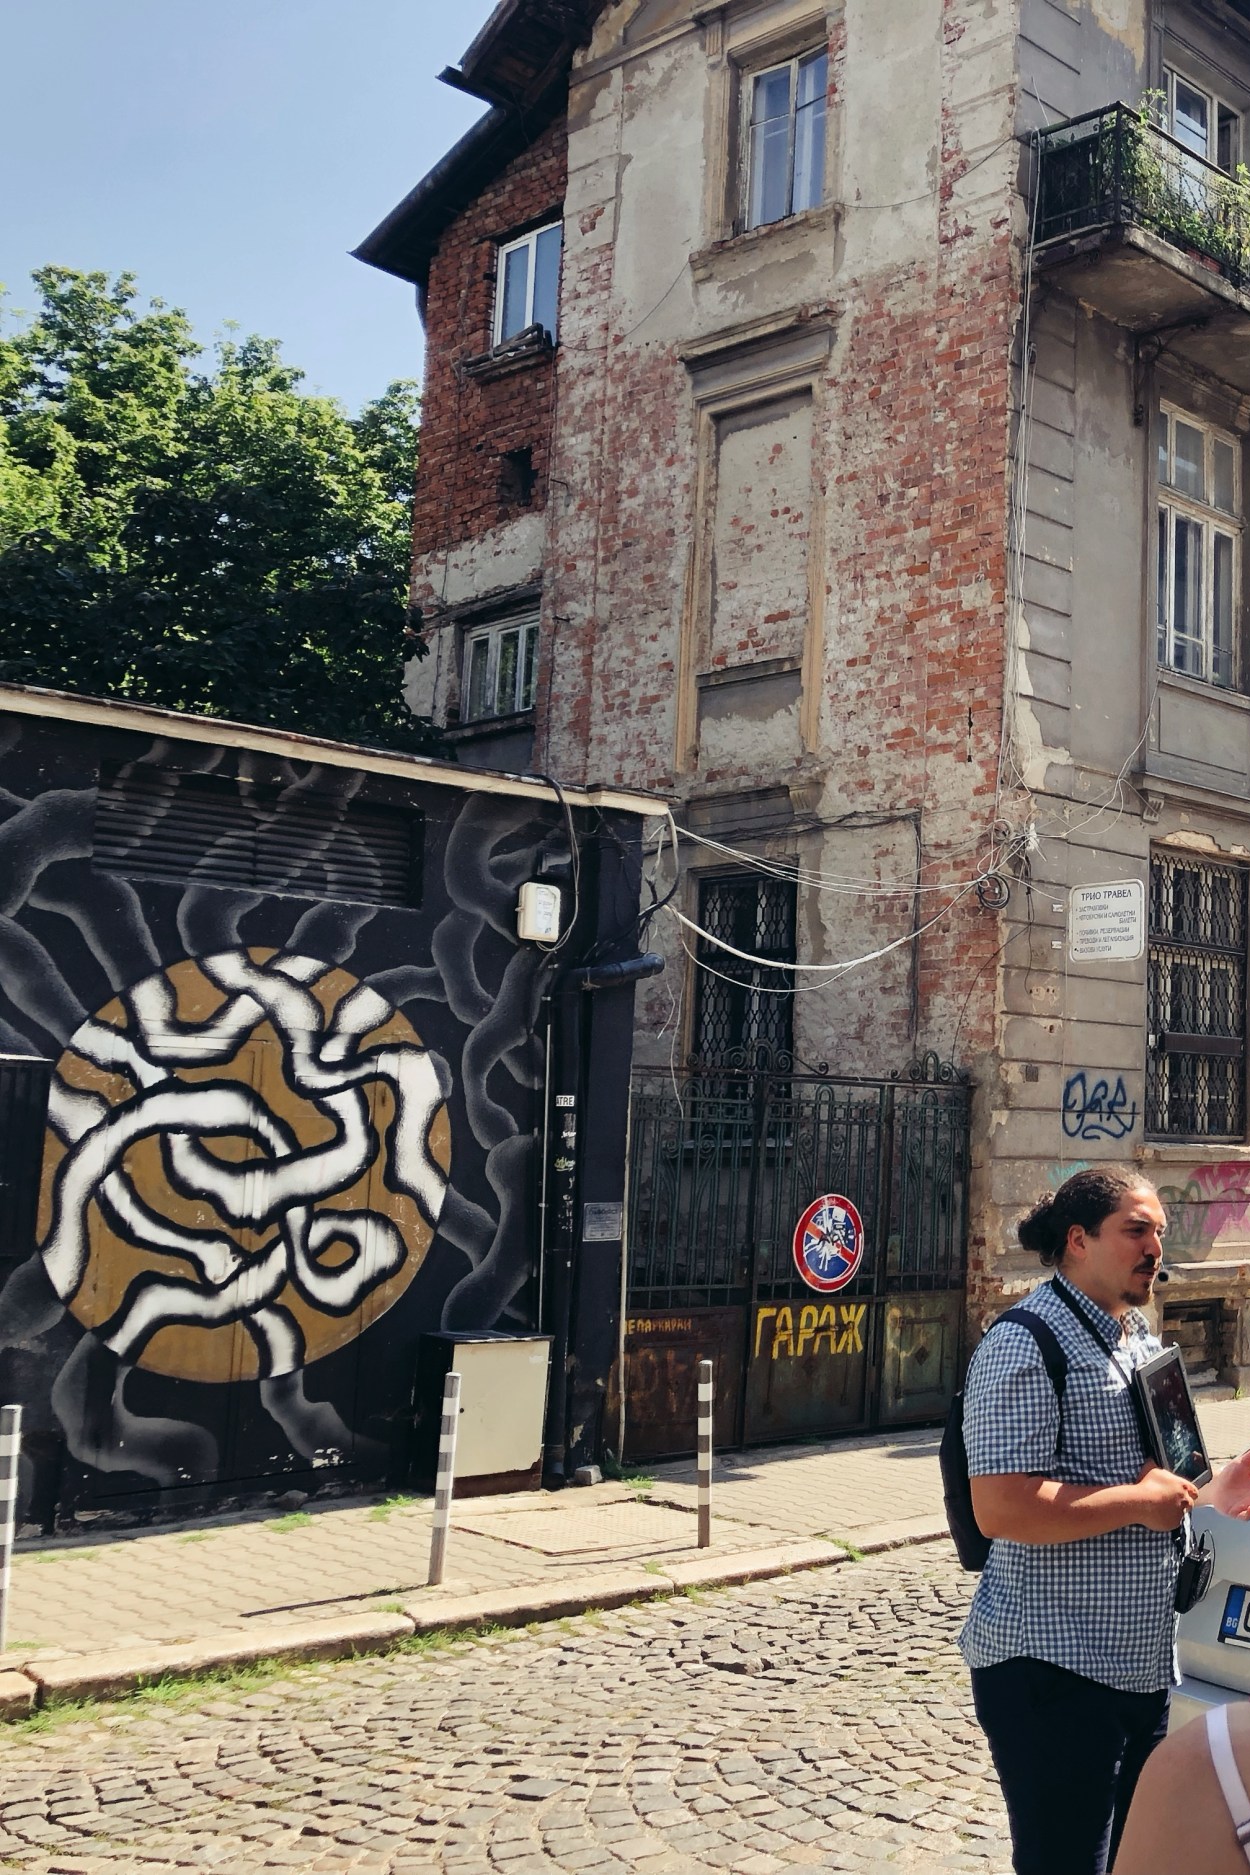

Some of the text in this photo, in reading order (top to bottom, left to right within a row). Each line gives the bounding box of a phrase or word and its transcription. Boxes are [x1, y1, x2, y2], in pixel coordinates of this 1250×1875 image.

[1081, 889, 1132, 901] ТРИО ТРАВЕЛ
[755, 1303, 867, 1360] ГАРАЖ
[1225, 1616, 1239, 1628] BG
